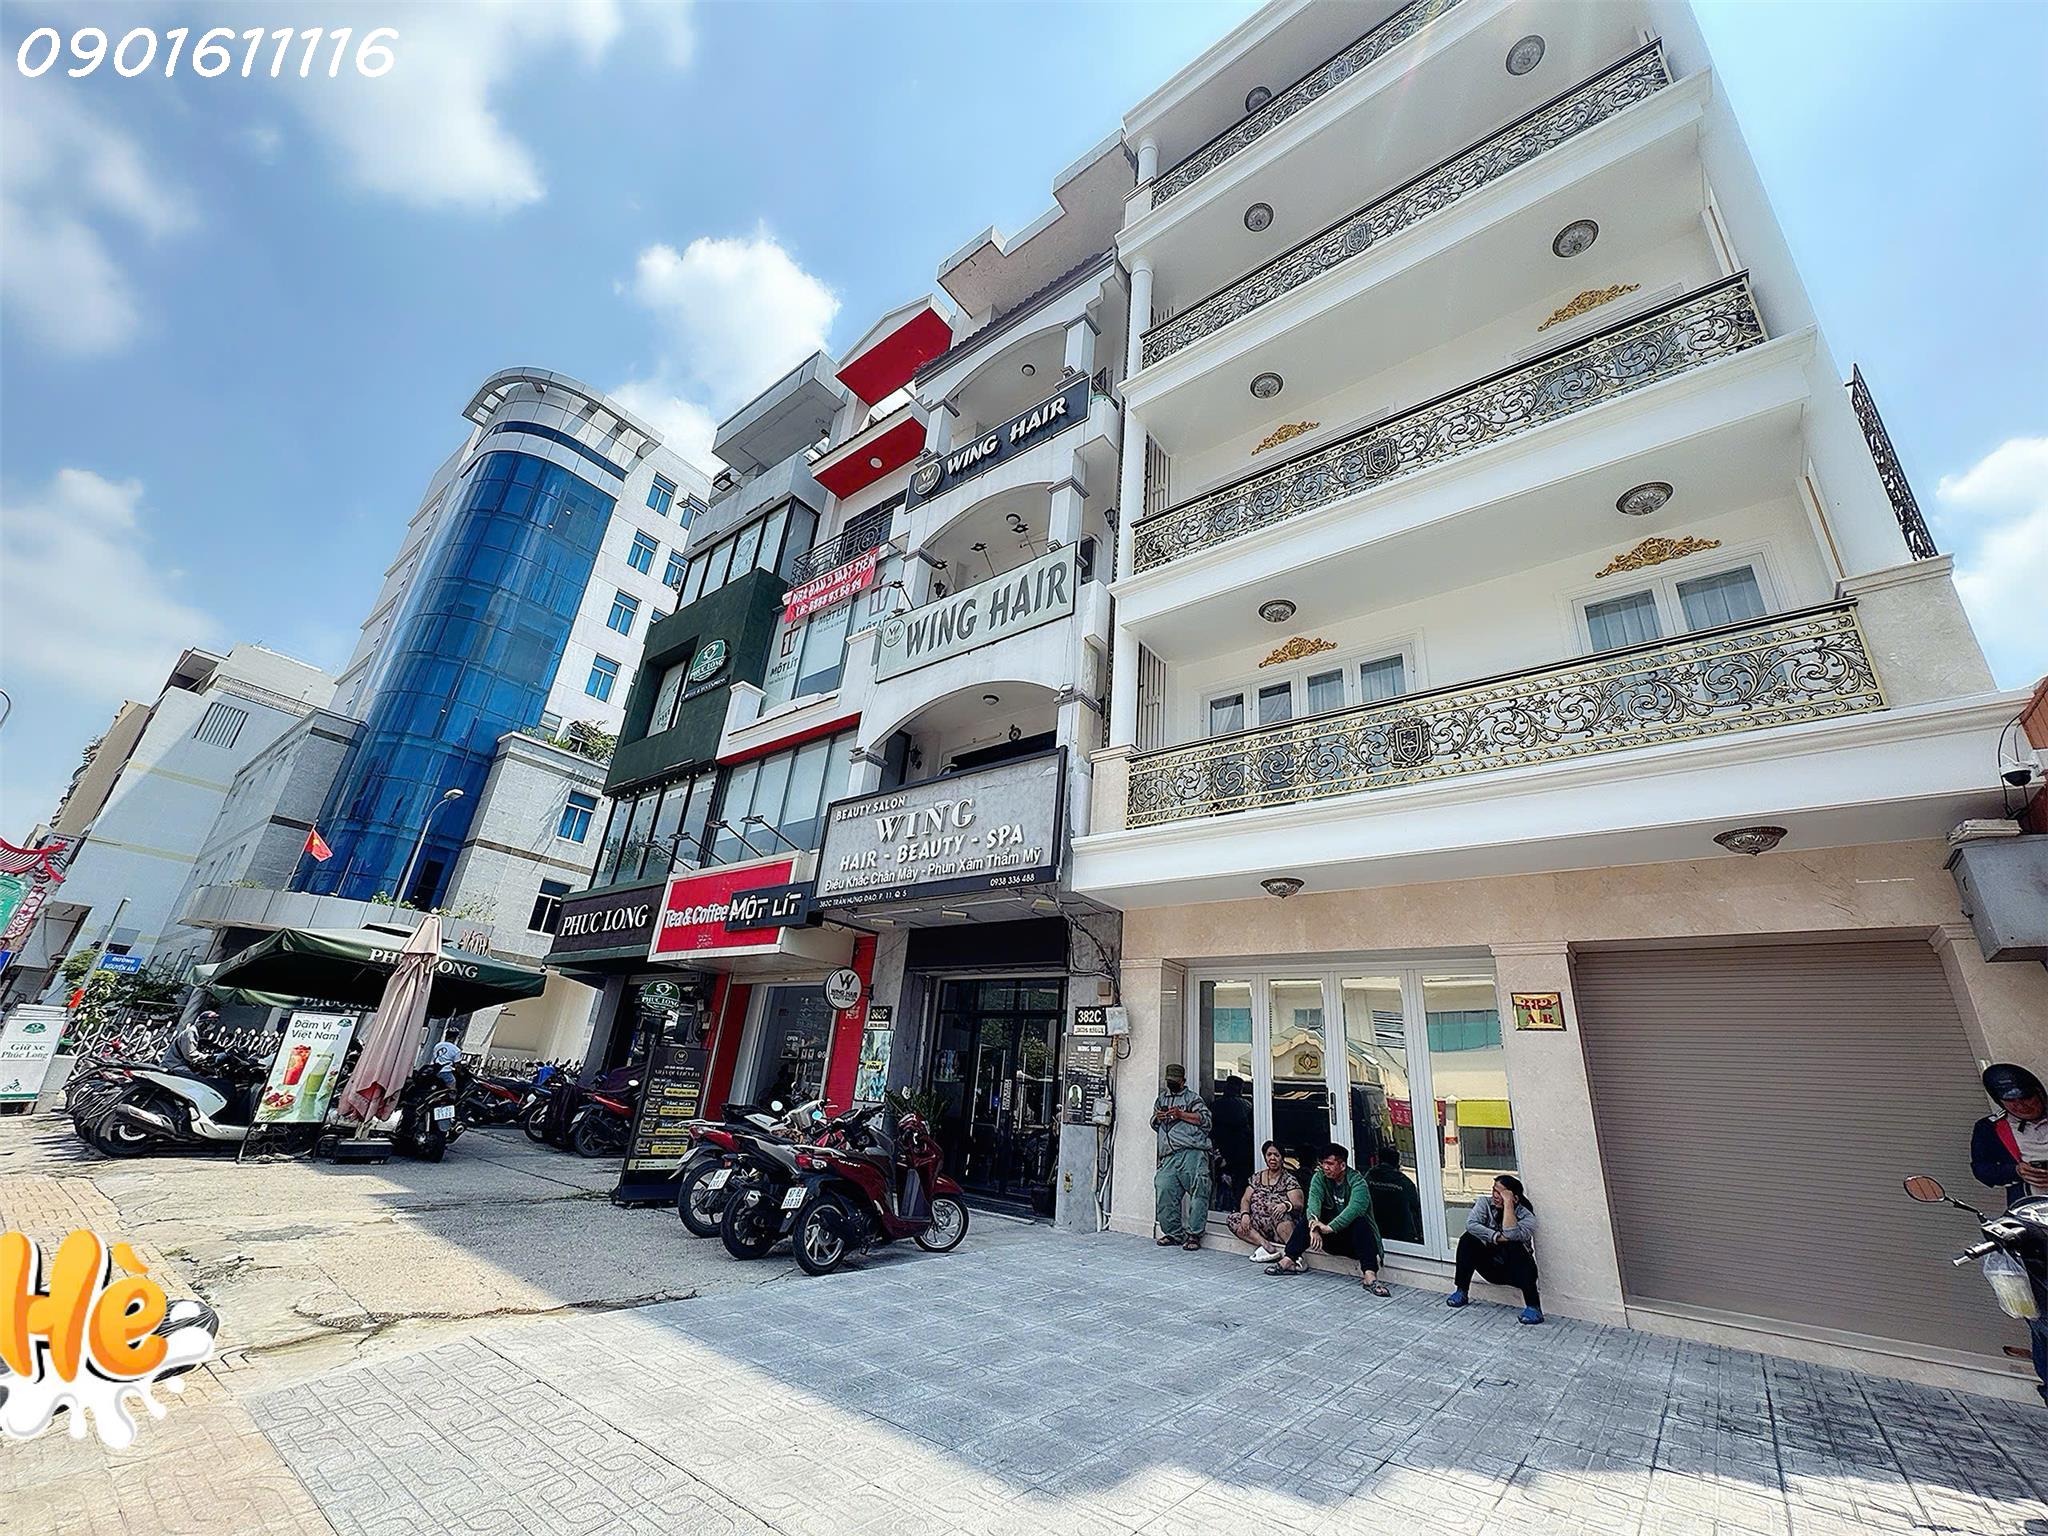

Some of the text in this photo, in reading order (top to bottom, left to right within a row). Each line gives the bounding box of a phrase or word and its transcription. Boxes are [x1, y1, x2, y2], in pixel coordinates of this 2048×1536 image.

[946, 396, 1067, 475] WING HAIR
[906, 560, 1068, 658] WING HAIR
[836, 796, 906, 822] BEAUTY SALON
[875, 798, 977, 843] WING
[840, 849, 877, 872] HAIR
[896, 834, 966, 864] BEAUTY
[986, 824, 1024, 849] SPA
[846, 871, 869, 889] Khắc
[870, 871, 895, 885] Chân
[897, 865, 919, 882] Mày
[927, 862, 956, 876] Phun
[958, 856, 983, 872] Xăm
[986, 848, 1019, 868] Thẩm
[1023, 847, 1042, 864] Mỹ
[559, 904, 650, 937] PHUC LONG
[728, 898, 769, 926] MỘT
[771, 892, 802, 917] LÍT
[292, 1029, 340, 1041] Việt Nam
[1078, 1009, 1102, 1023] 382C
